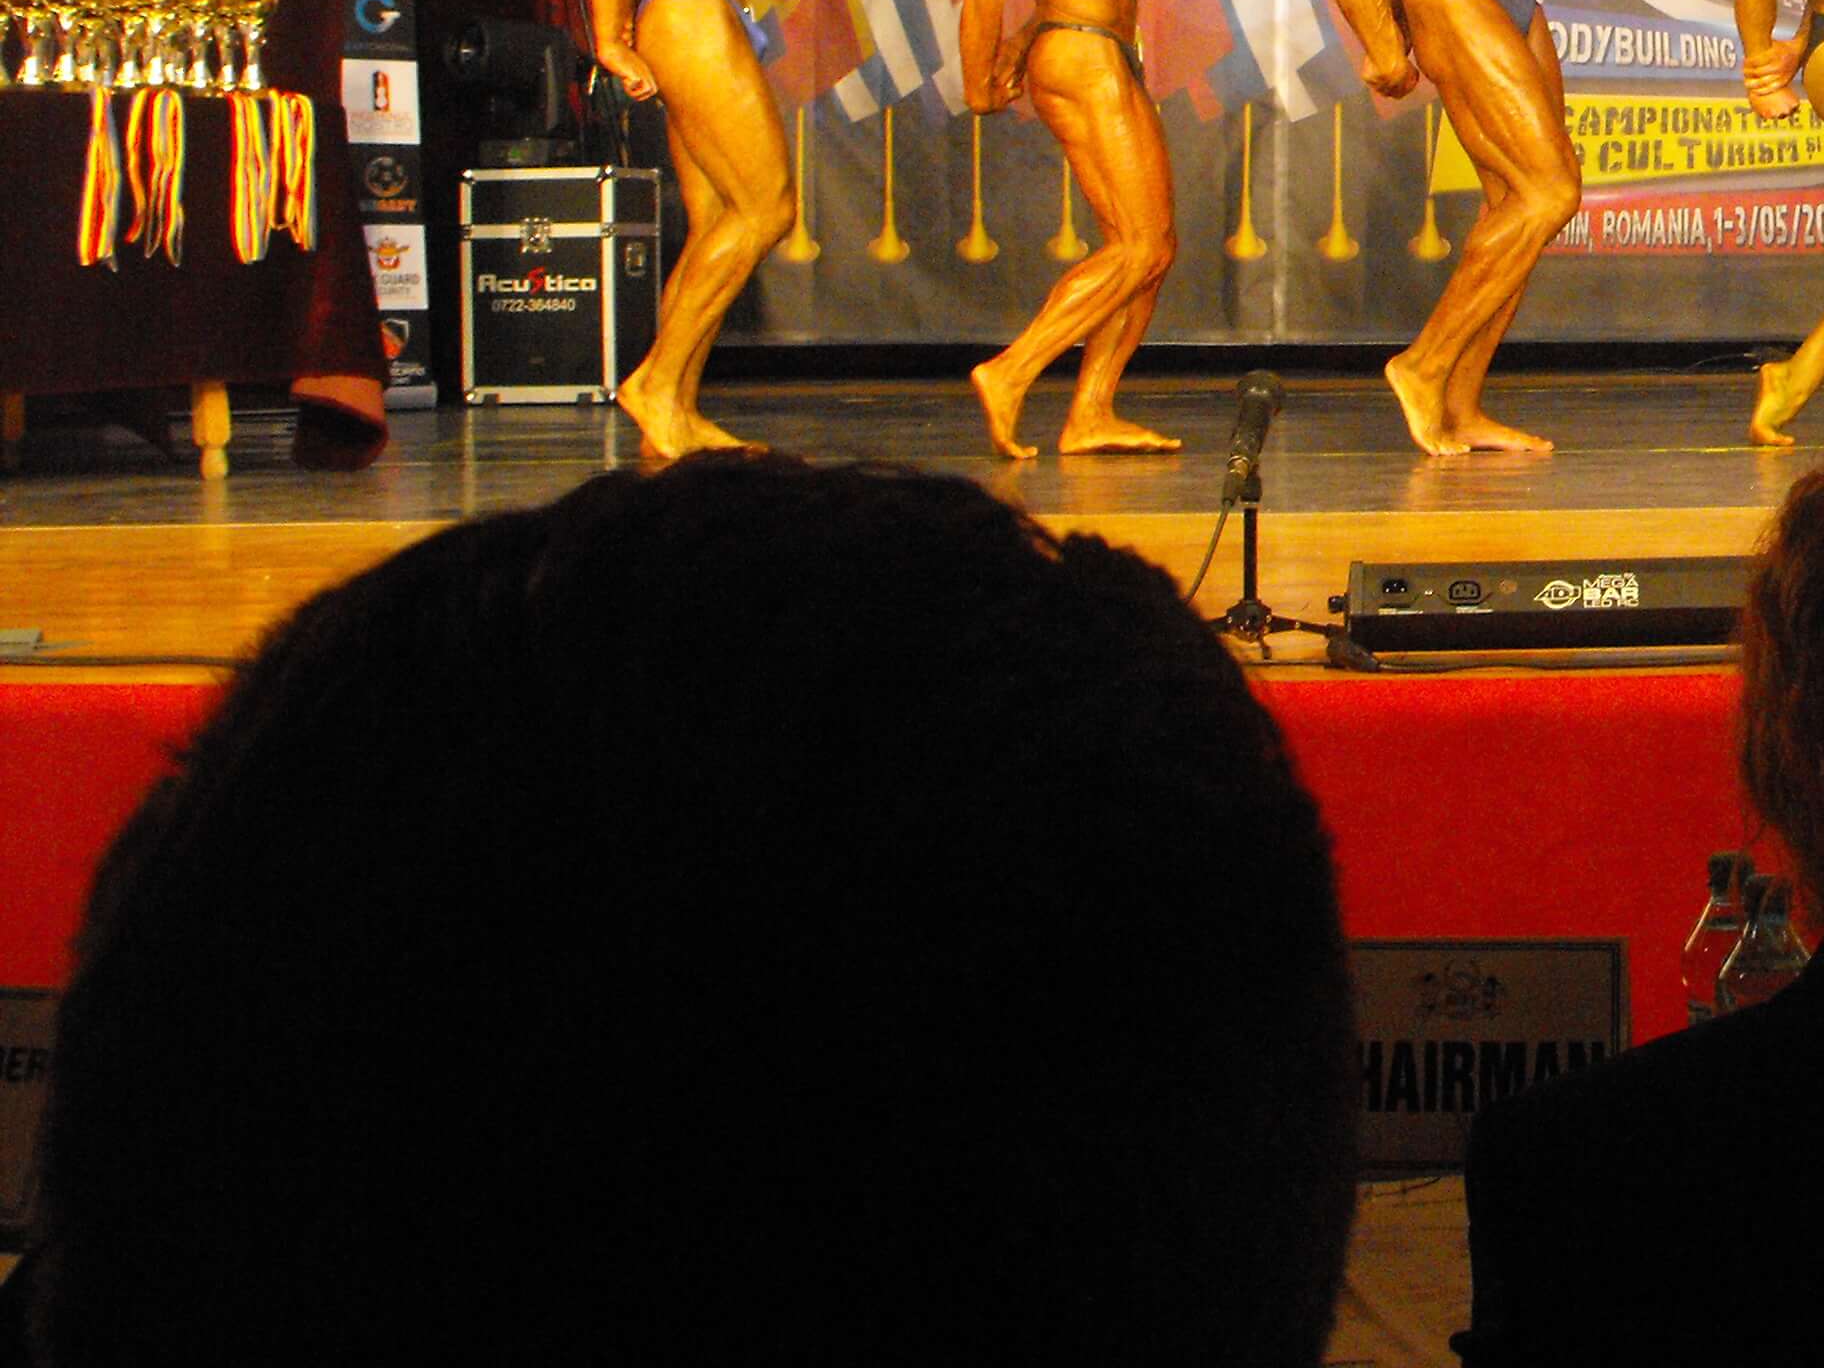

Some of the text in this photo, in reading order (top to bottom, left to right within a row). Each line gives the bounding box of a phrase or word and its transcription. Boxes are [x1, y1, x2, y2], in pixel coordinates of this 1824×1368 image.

[1547, 21, 1737, 69] ODYBUILDING
[1599, 136, 1800, 174] CULTURISM
[1582, 576, 1640, 589] MEGA
[1582, 587, 1640, 601] BAR
